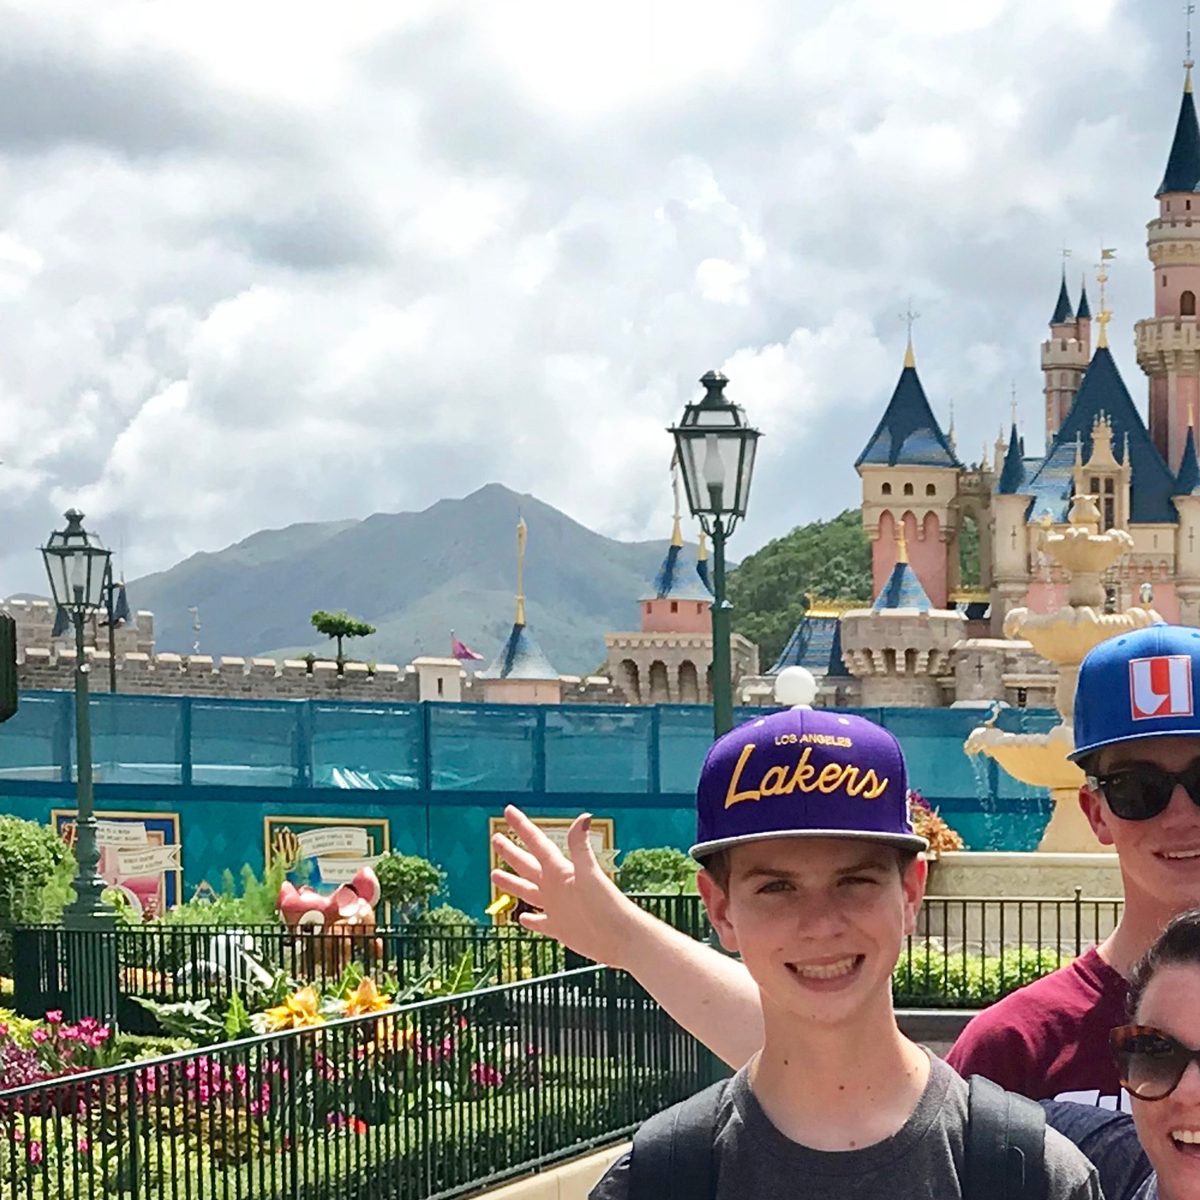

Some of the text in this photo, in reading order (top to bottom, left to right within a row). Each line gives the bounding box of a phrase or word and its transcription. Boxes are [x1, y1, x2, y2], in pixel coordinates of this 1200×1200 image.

[774, 733, 853, 748] LOS ANGELES
[724, 743, 889, 810] Lakers
